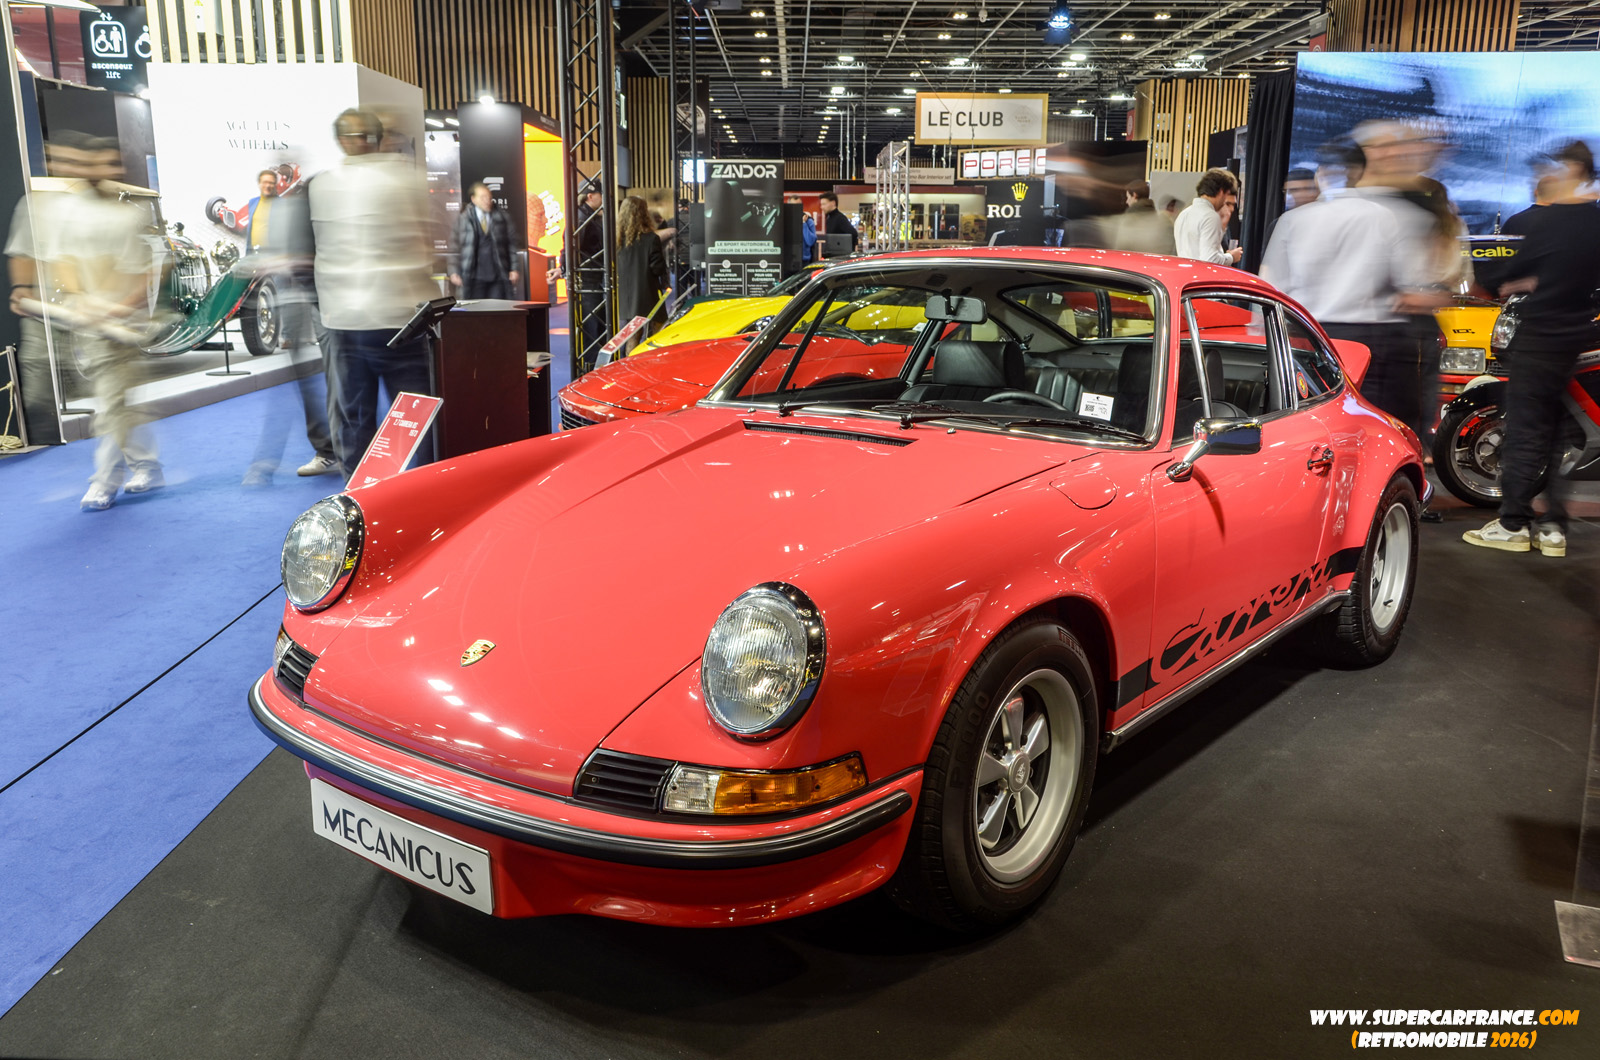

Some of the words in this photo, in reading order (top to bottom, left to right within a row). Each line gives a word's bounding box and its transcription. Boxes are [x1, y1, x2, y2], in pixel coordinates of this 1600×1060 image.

[91, 62, 134, 70] ascenseur
[105, 70, 122, 79] lift
[928, 111, 950, 127] LE
[955, 111, 1004, 127] CLUB
[227, 139, 290, 150] WHEELS
[710, 164, 778, 179] ZANDOR
[1472, 246, 1518, 258] calb
[1151, 556, 1334, 684] Carrera
[322, 799, 477, 895] MECANICUS
